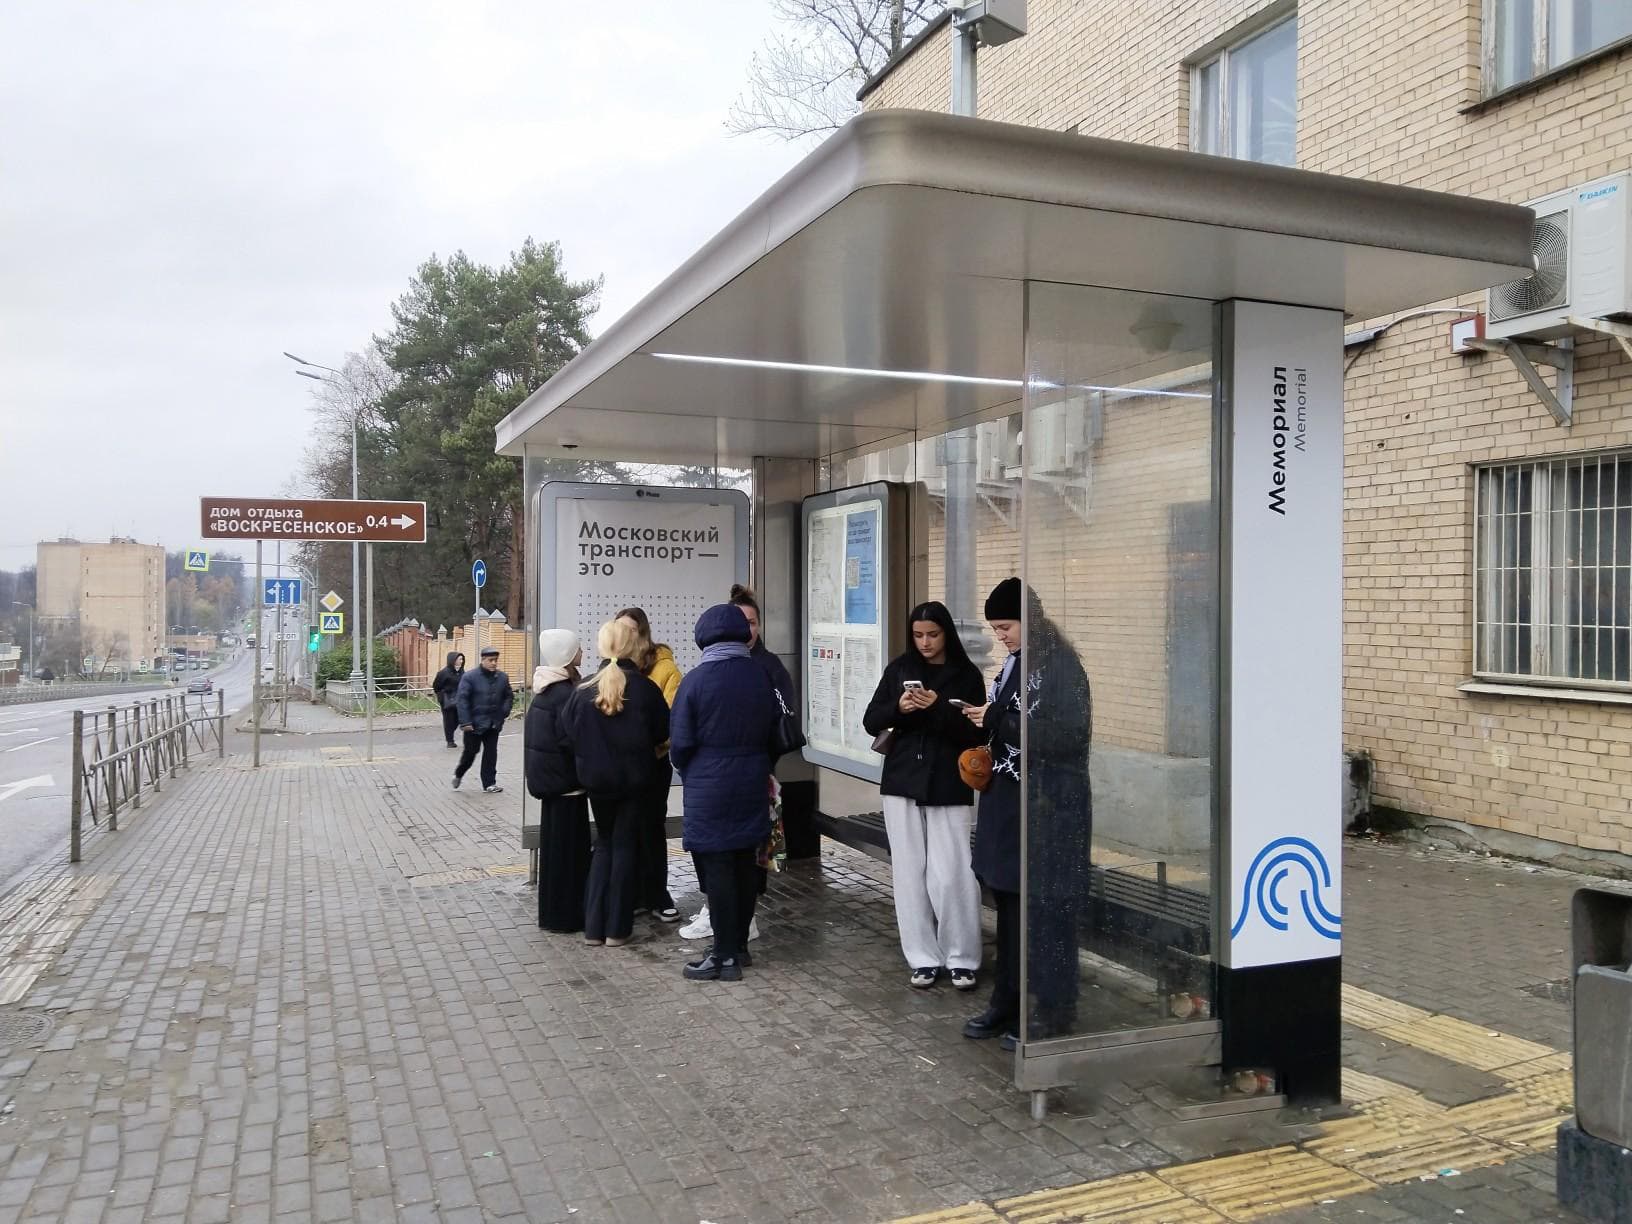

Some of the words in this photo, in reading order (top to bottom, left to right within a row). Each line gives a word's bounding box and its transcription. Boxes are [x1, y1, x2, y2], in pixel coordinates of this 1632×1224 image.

[1294, 368, 1307, 452] Memorial
[1268, 366, 1290, 516] Мемориал
[209, 507, 241, 518] дом
[247, 507, 303, 519] отдыха
[210, 519, 364, 534] «ВОСКРЕСЕНСКОЕ»
[366, 515, 389, 529] 0,4
[578, 521, 719, 544] Московский
[578, 543, 695, 563] транспорт
[578, 562, 615, 576] это
